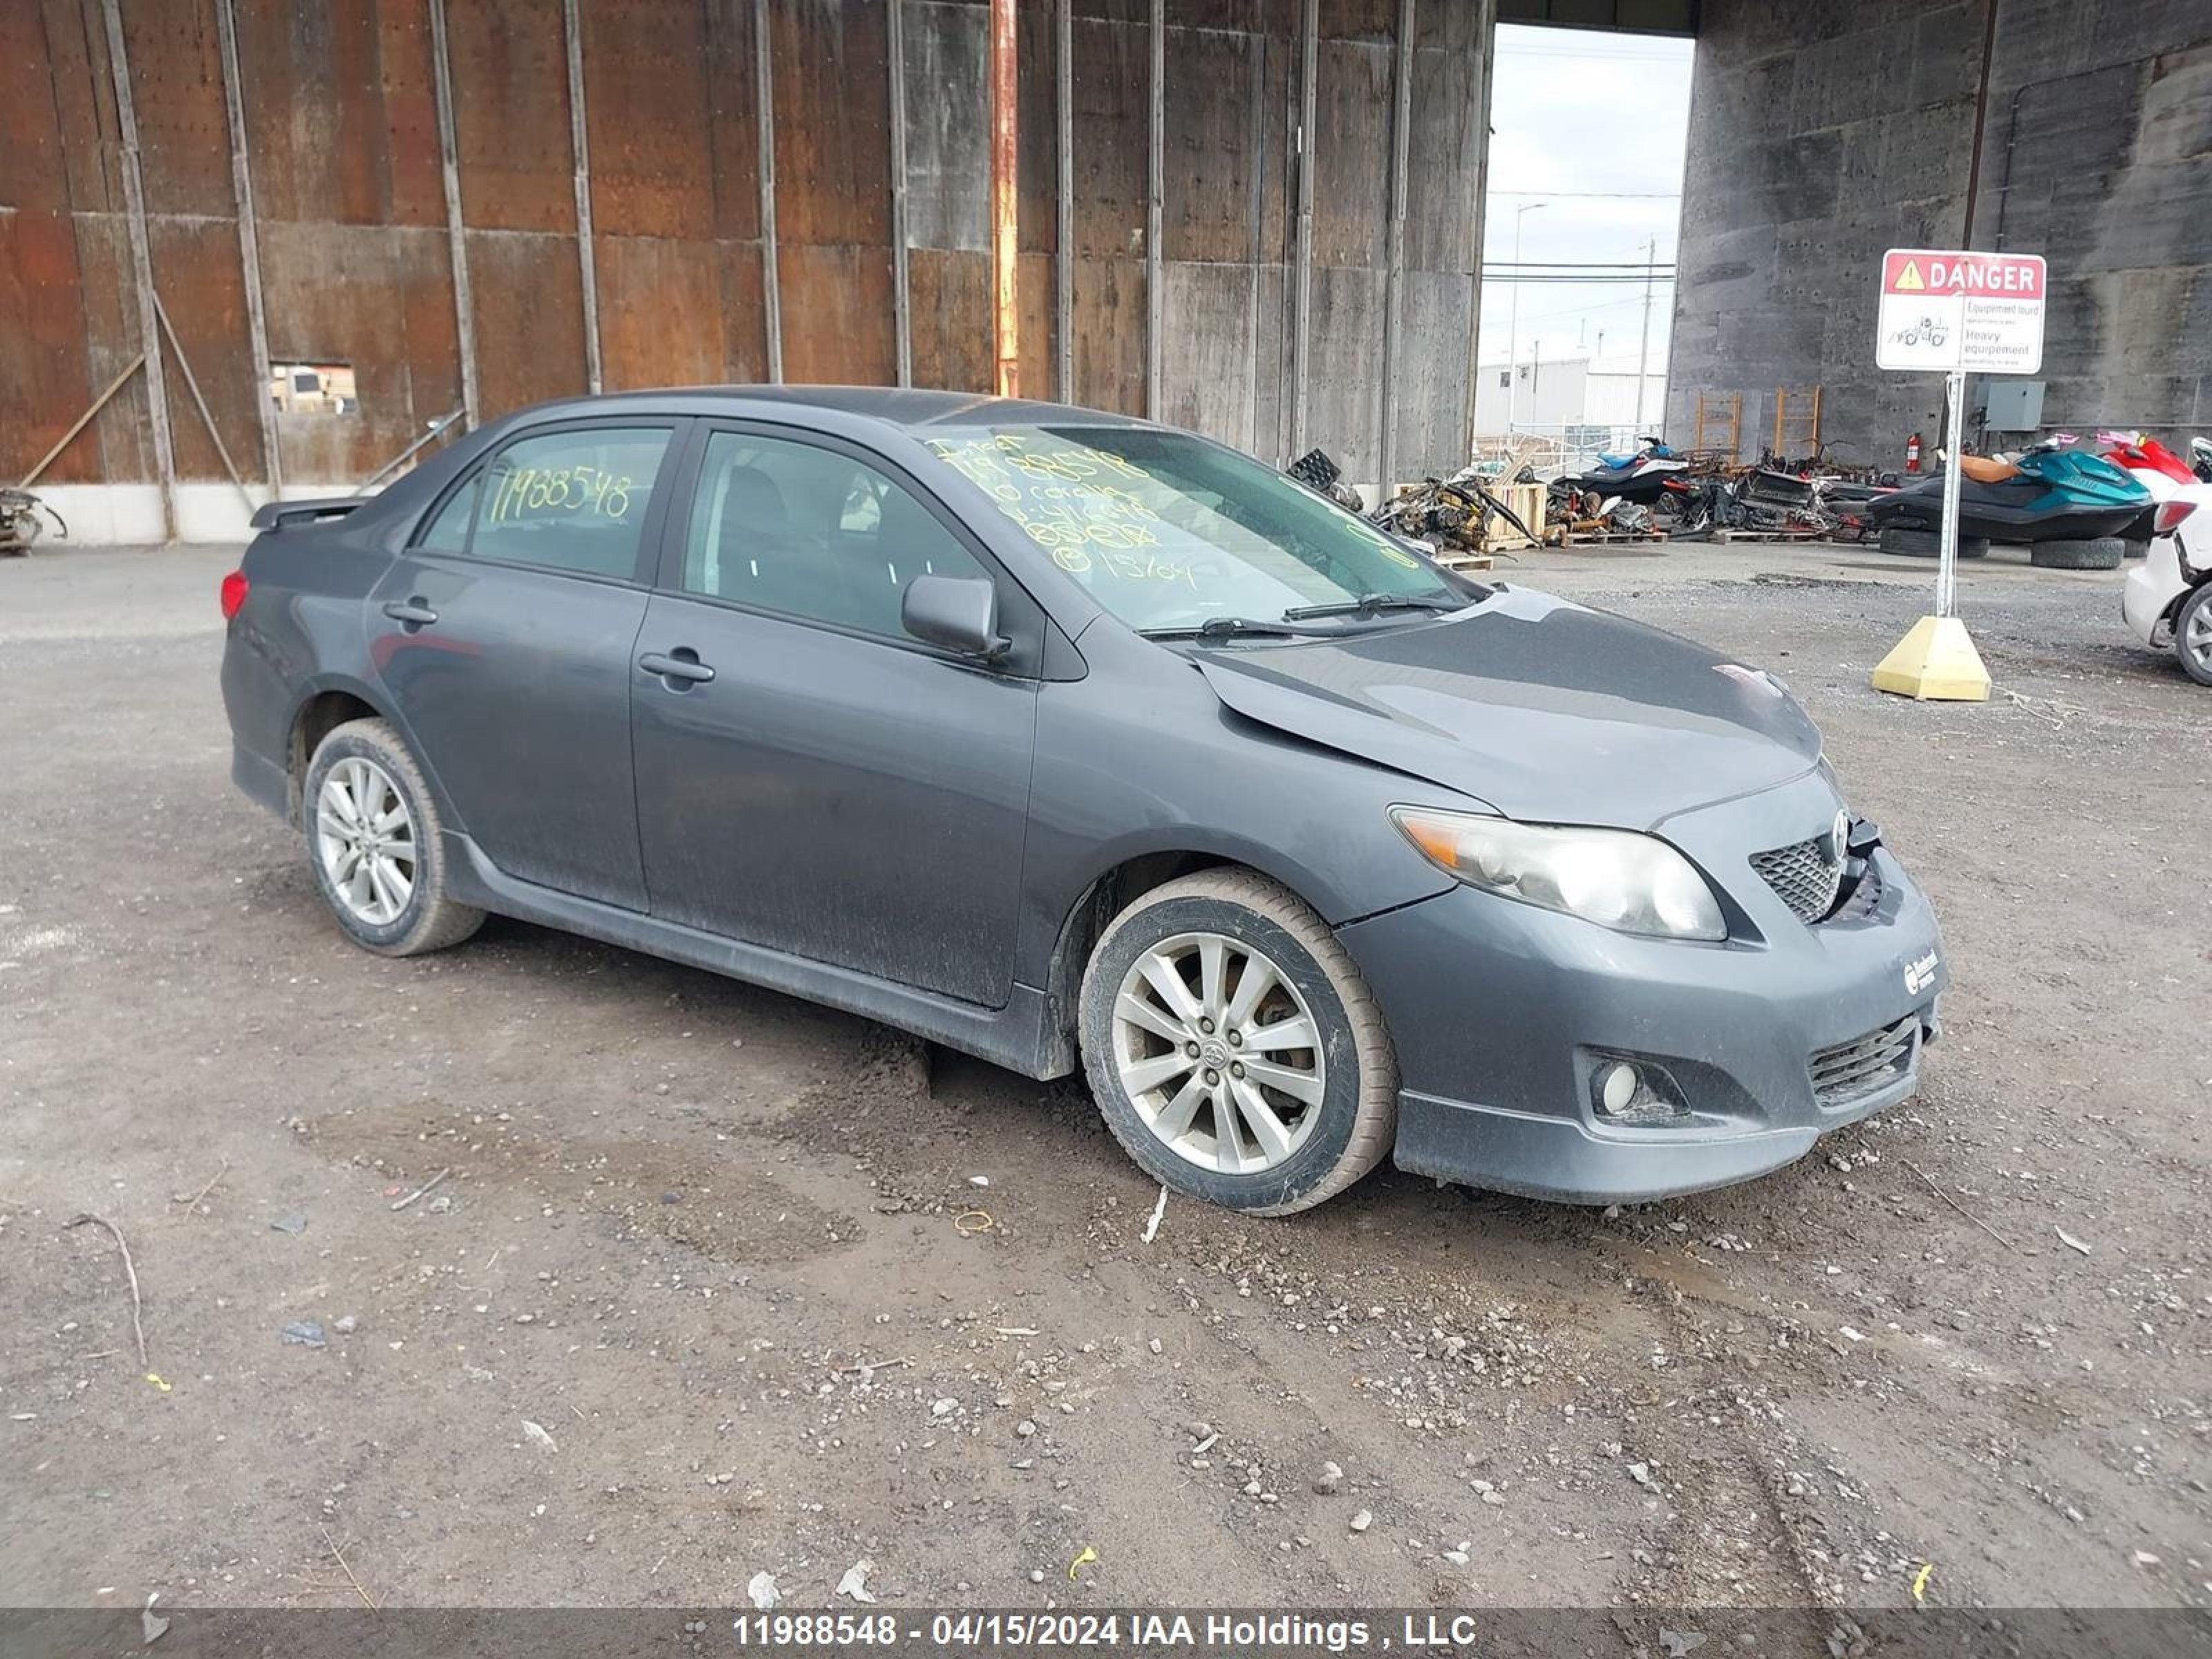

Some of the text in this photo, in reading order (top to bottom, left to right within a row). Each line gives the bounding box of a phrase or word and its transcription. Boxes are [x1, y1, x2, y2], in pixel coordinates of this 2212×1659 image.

[1929, 262, 2034, 291] DANGER
[1965, 330, 2000, 343] Heavy
[490, 466, 631, 523] 11988548
